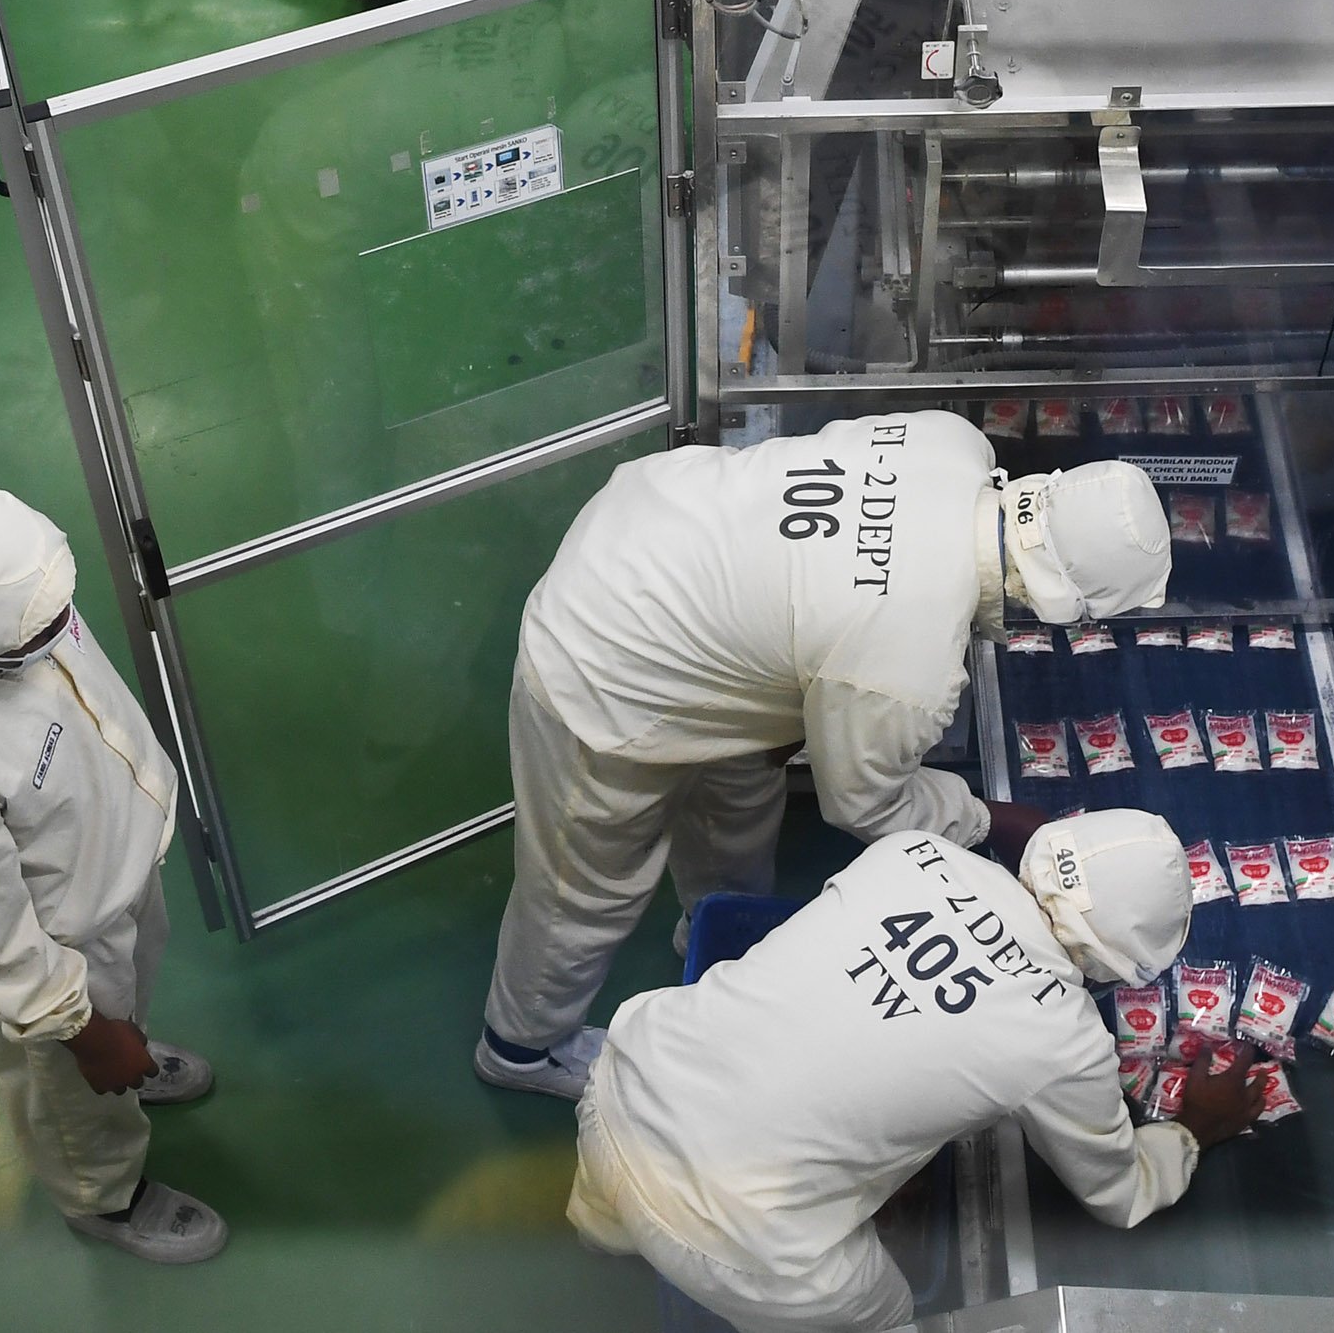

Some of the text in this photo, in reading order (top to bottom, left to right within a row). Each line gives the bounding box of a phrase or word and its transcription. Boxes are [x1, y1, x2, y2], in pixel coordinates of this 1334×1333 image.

[455, 154, 469, 163] Start
[507, 137, 528, 147] SANKO
[1120, 457, 1235, 466] PENGAMBILAN PRODUK
[779, 459, 846, 540] 106
[1017, 490, 1035, 525] 106
[845, 946, 923, 1020] TW
[881, 911, 995, 1014] 405
